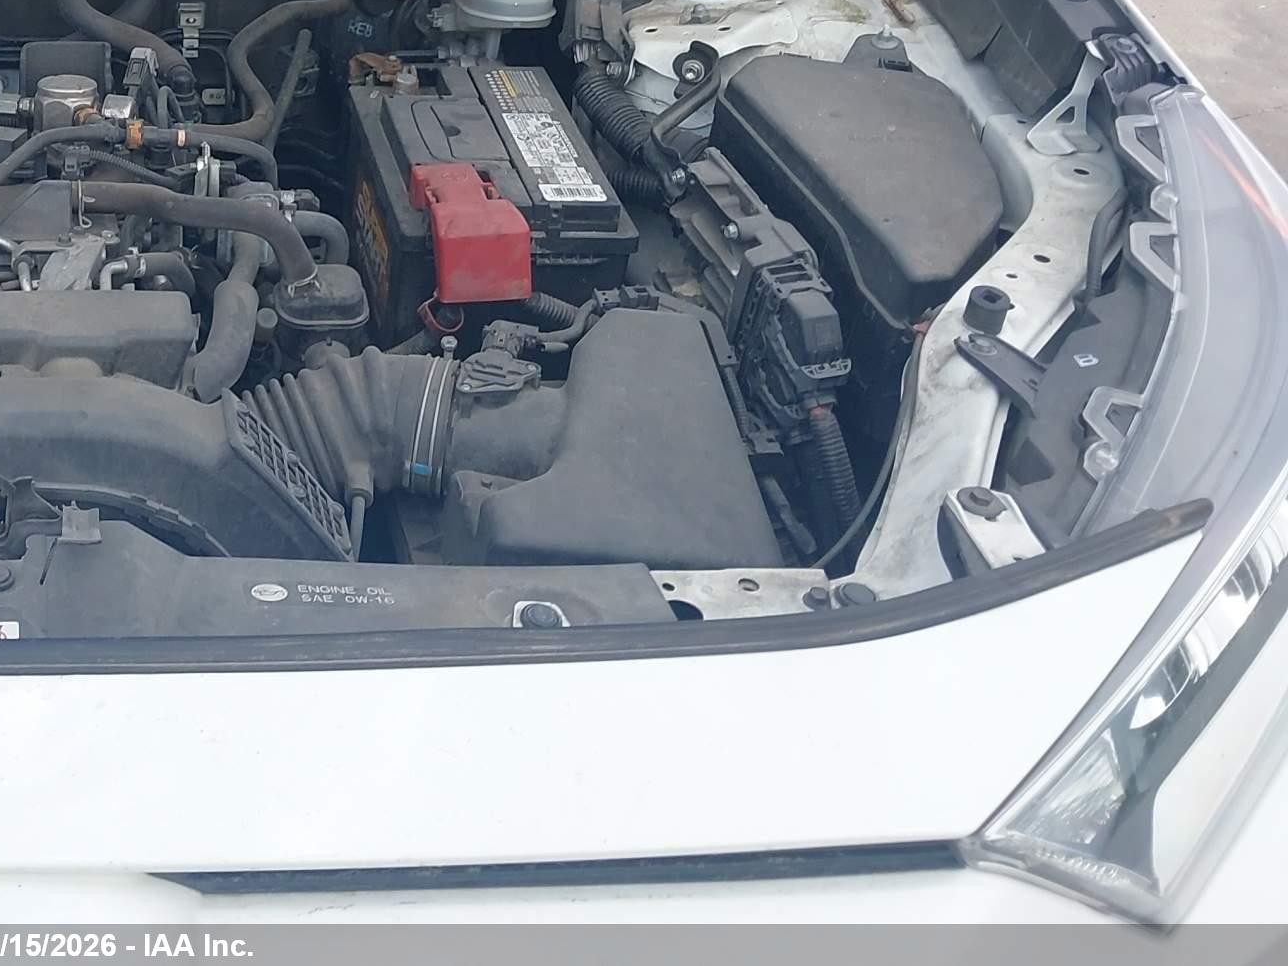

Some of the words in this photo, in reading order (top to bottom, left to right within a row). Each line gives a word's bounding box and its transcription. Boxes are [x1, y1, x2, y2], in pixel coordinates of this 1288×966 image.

[297, 584, 357, 595] ENGINE
[366, 586, 393, 596] OIL
[301, 593, 335, 603] SAE
[344, 595, 396, 605] 0W-16
